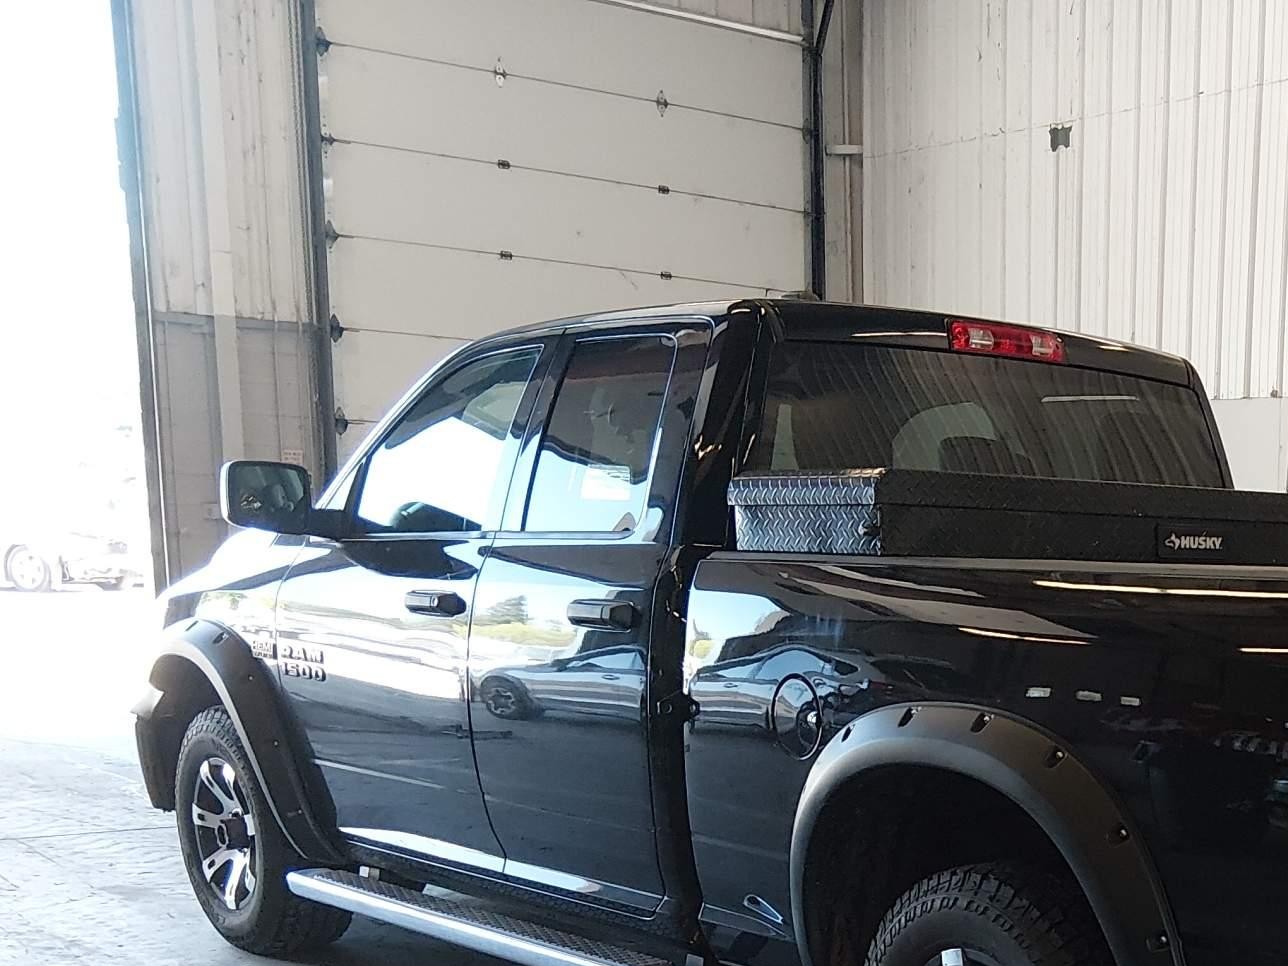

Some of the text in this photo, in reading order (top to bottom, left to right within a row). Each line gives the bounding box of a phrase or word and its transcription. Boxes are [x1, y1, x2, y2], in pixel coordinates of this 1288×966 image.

[1180, 531, 1222, 549] HUSKY
[281, 645, 324, 664] RAM
[282, 661, 326, 682] 1500
